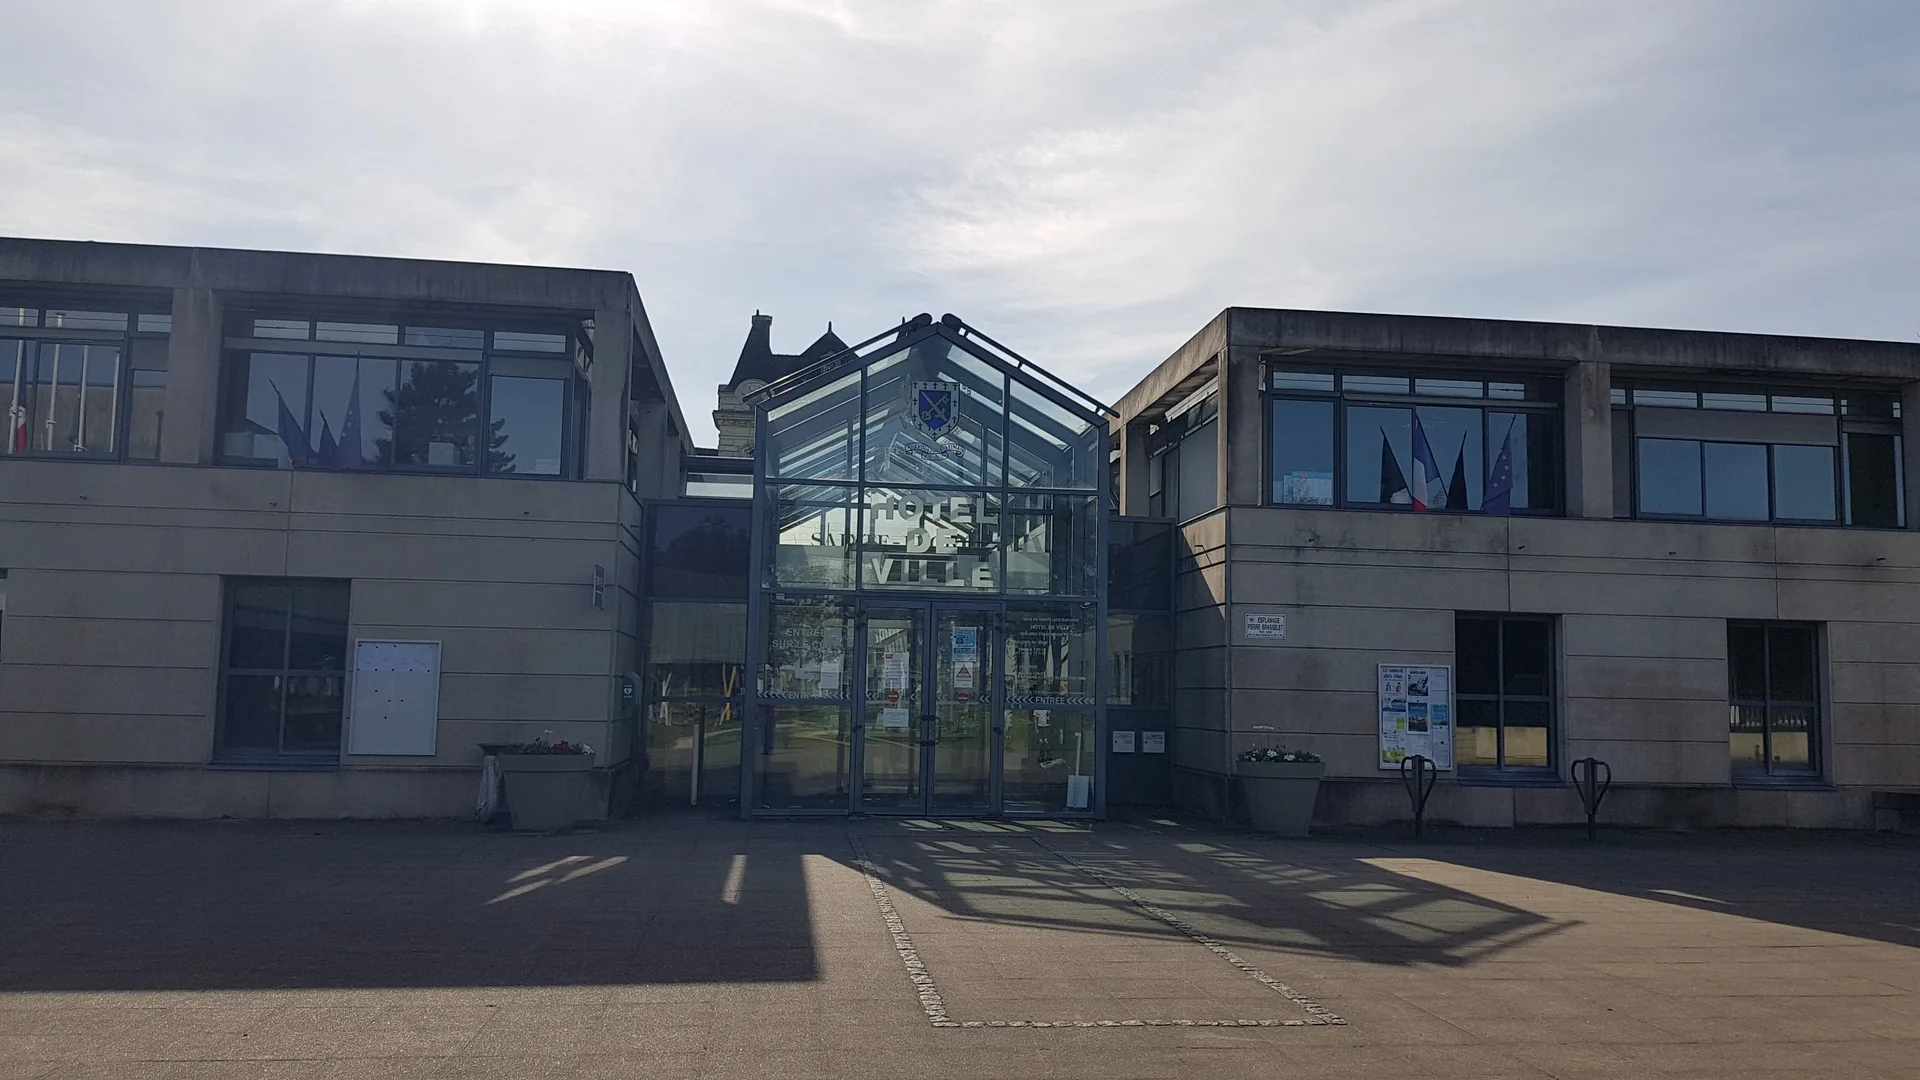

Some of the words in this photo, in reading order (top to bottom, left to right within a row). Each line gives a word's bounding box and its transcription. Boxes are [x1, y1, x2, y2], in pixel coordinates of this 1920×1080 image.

[907, 528, 958, 554] DE
[871, 558, 994, 588] VILLE
[772, 639, 794, 649] SUR
[1035, 696, 1065, 704] ENTRÉE
